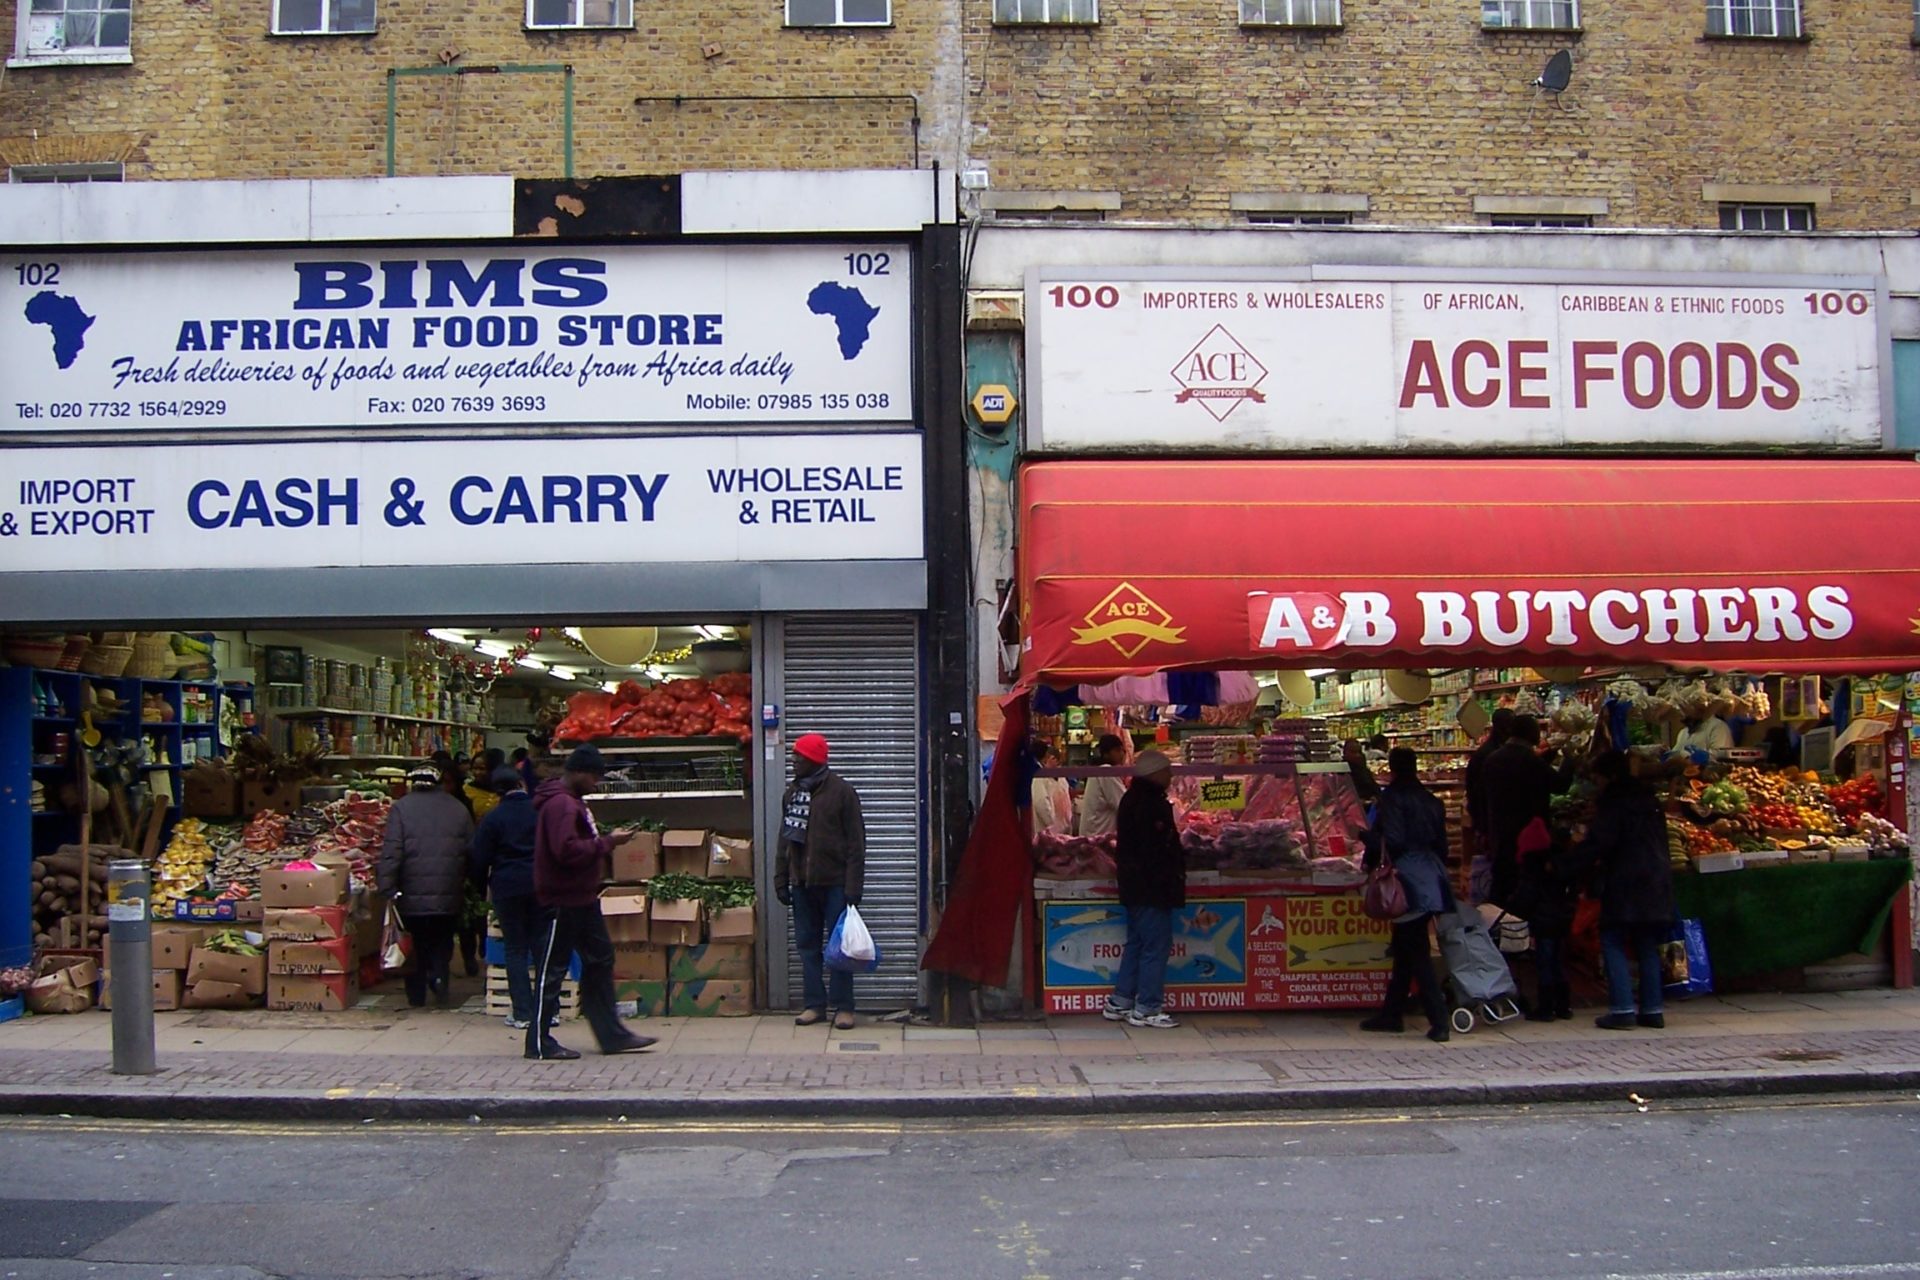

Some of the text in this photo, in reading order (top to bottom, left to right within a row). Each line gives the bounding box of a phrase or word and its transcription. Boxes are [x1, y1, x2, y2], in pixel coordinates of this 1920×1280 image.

[14, 262, 61, 286] 102
[843, 252, 891, 276] 102
[292, 257, 609, 311] BIMS
[1048, 284, 1120, 309] 100
[1143, 291, 1785, 315] IMPORTERS & WHOLESALERS OF AFRICAN, CARIBBEAN & ETHNIC FOODS
[1803, 292, 1869, 316] 100
[175, 313, 723, 352] AFRICAN FOOD STORE
[110, 349, 794, 392] Fresh deliveries of foods and vegetables from Africa daily
[1186, 351, 1248, 382] ACE
[1398, 339, 1801, 411] ACE FOODS
[15, 399, 227, 419] Tel: 020 7732 1564/2929
[368, 395, 546, 414] Fax: 020 7639 3693
[686, 392, 890, 410] Mobile: 07985 135 038
[983, 397, 1005, 410] ADT
[20, 478, 136, 505] IMPORT
[706, 466, 903, 494] WHOLESALE
[186, 473, 670, 530] CASH & CARRY
[738, 497, 876, 525] & RETAIL
[0, 509, 156, 537] & EXPORT
[1106, 602, 1150, 618] ACE
[1415, 585, 1853, 646] BUTCHERS
[1288, 900, 1365, 916] WE CU
[1288, 918, 1394, 935] YOUR CHOI
[1257, 954, 1276, 964] FROM
[1254, 967, 1281, 977] AROUND
[1260, 980, 1274, 989] THE
[1332, 983, 1349, 991] CAT
[1052, 995, 1082, 1010] THE
[1085, 994, 1110, 1010] BES
[1181, 993, 1195, 1007] IN
[1197, 992, 1245, 1007] TOWN!
